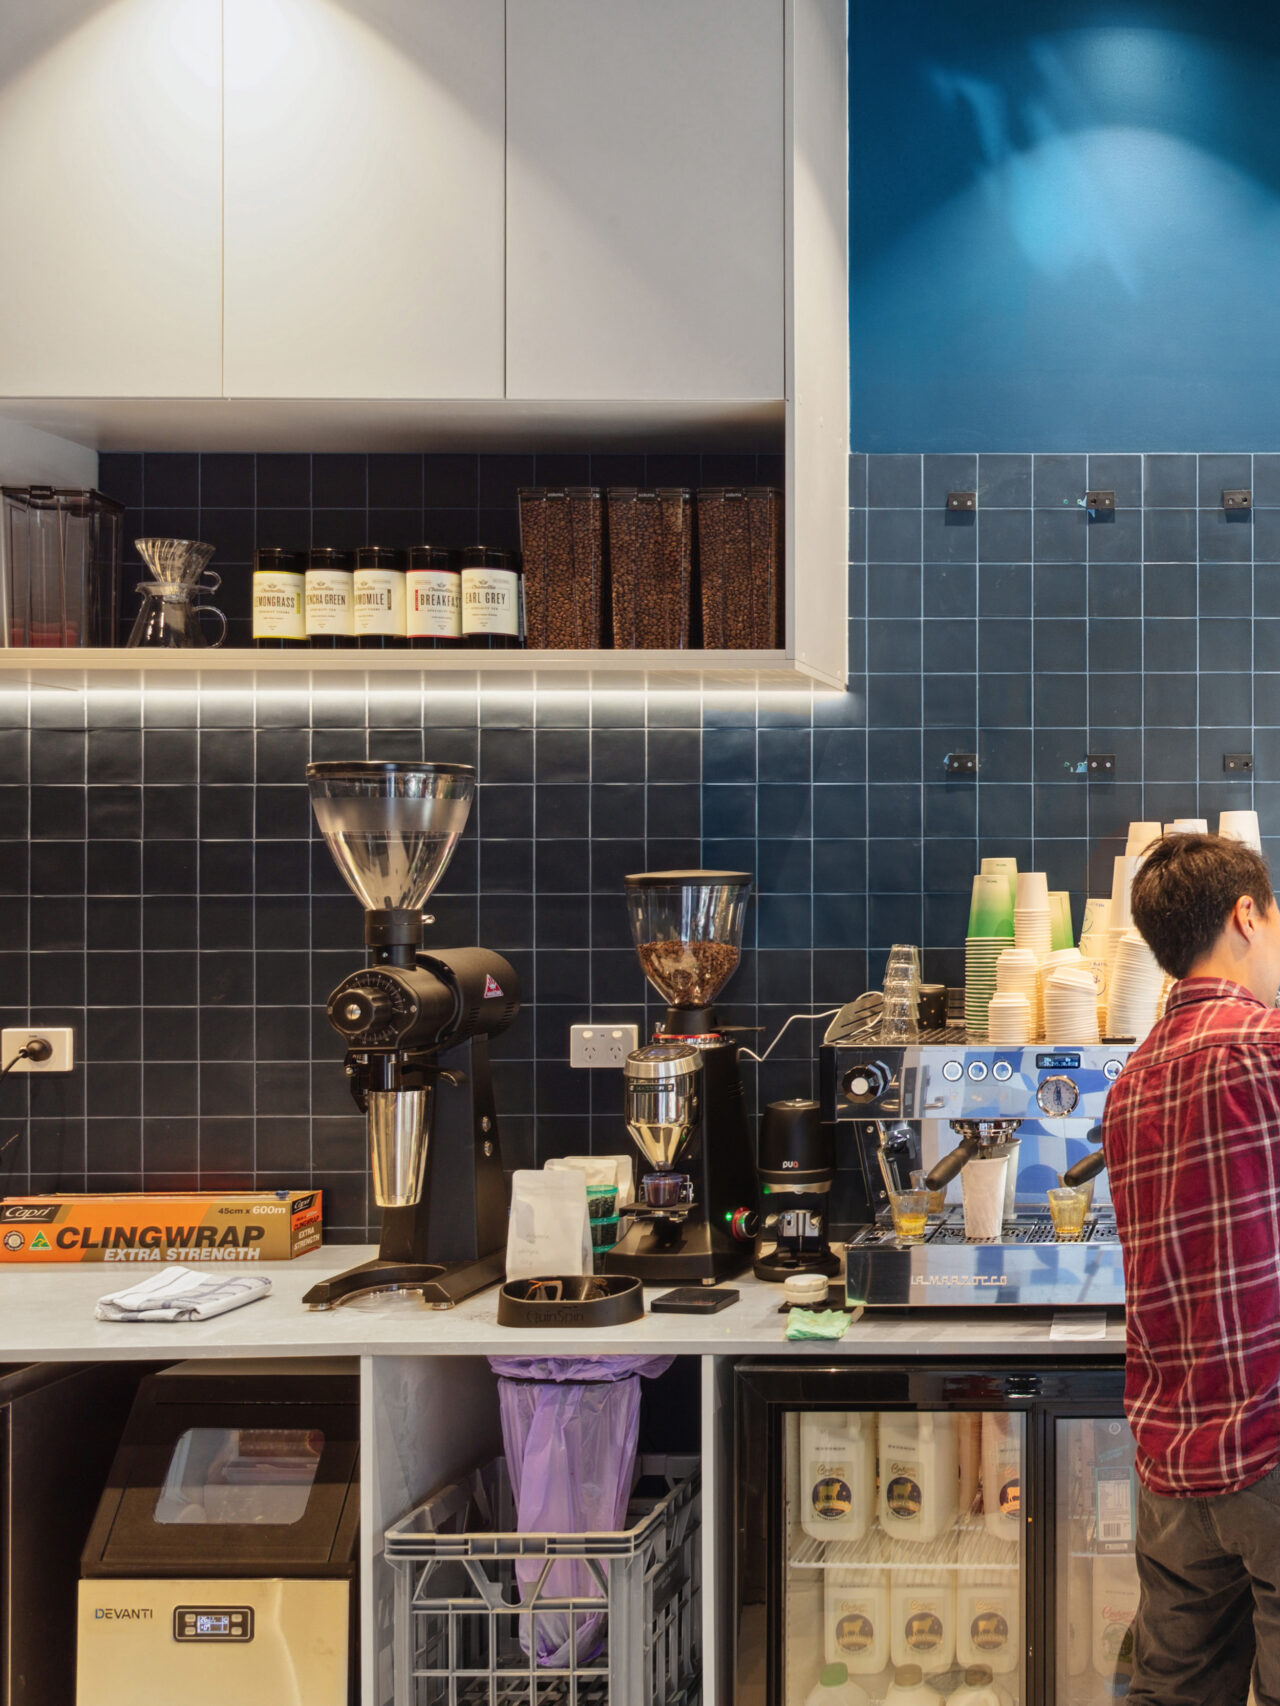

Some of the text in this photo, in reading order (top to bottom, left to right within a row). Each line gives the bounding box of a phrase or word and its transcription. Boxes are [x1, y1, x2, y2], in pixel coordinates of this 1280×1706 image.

[324, 593, 346, 606] GREEN
[465, 591, 506, 605] EARL GREY
[5, 1205, 50, 1219] Capri
[218, 1207, 243, 1215] 45cm
[252, 1205, 286, 1215] 600m
[56, 1225, 265, 1250] CLINGWRAP
[298, 1226, 315, 1239] EXTRA
[294, 1234, 320, 1250] STRENGTH
[104, 1247, 260, 1261] EXTRA STRENGTH
[95, 1608, 153, 1619] DEVANTI
